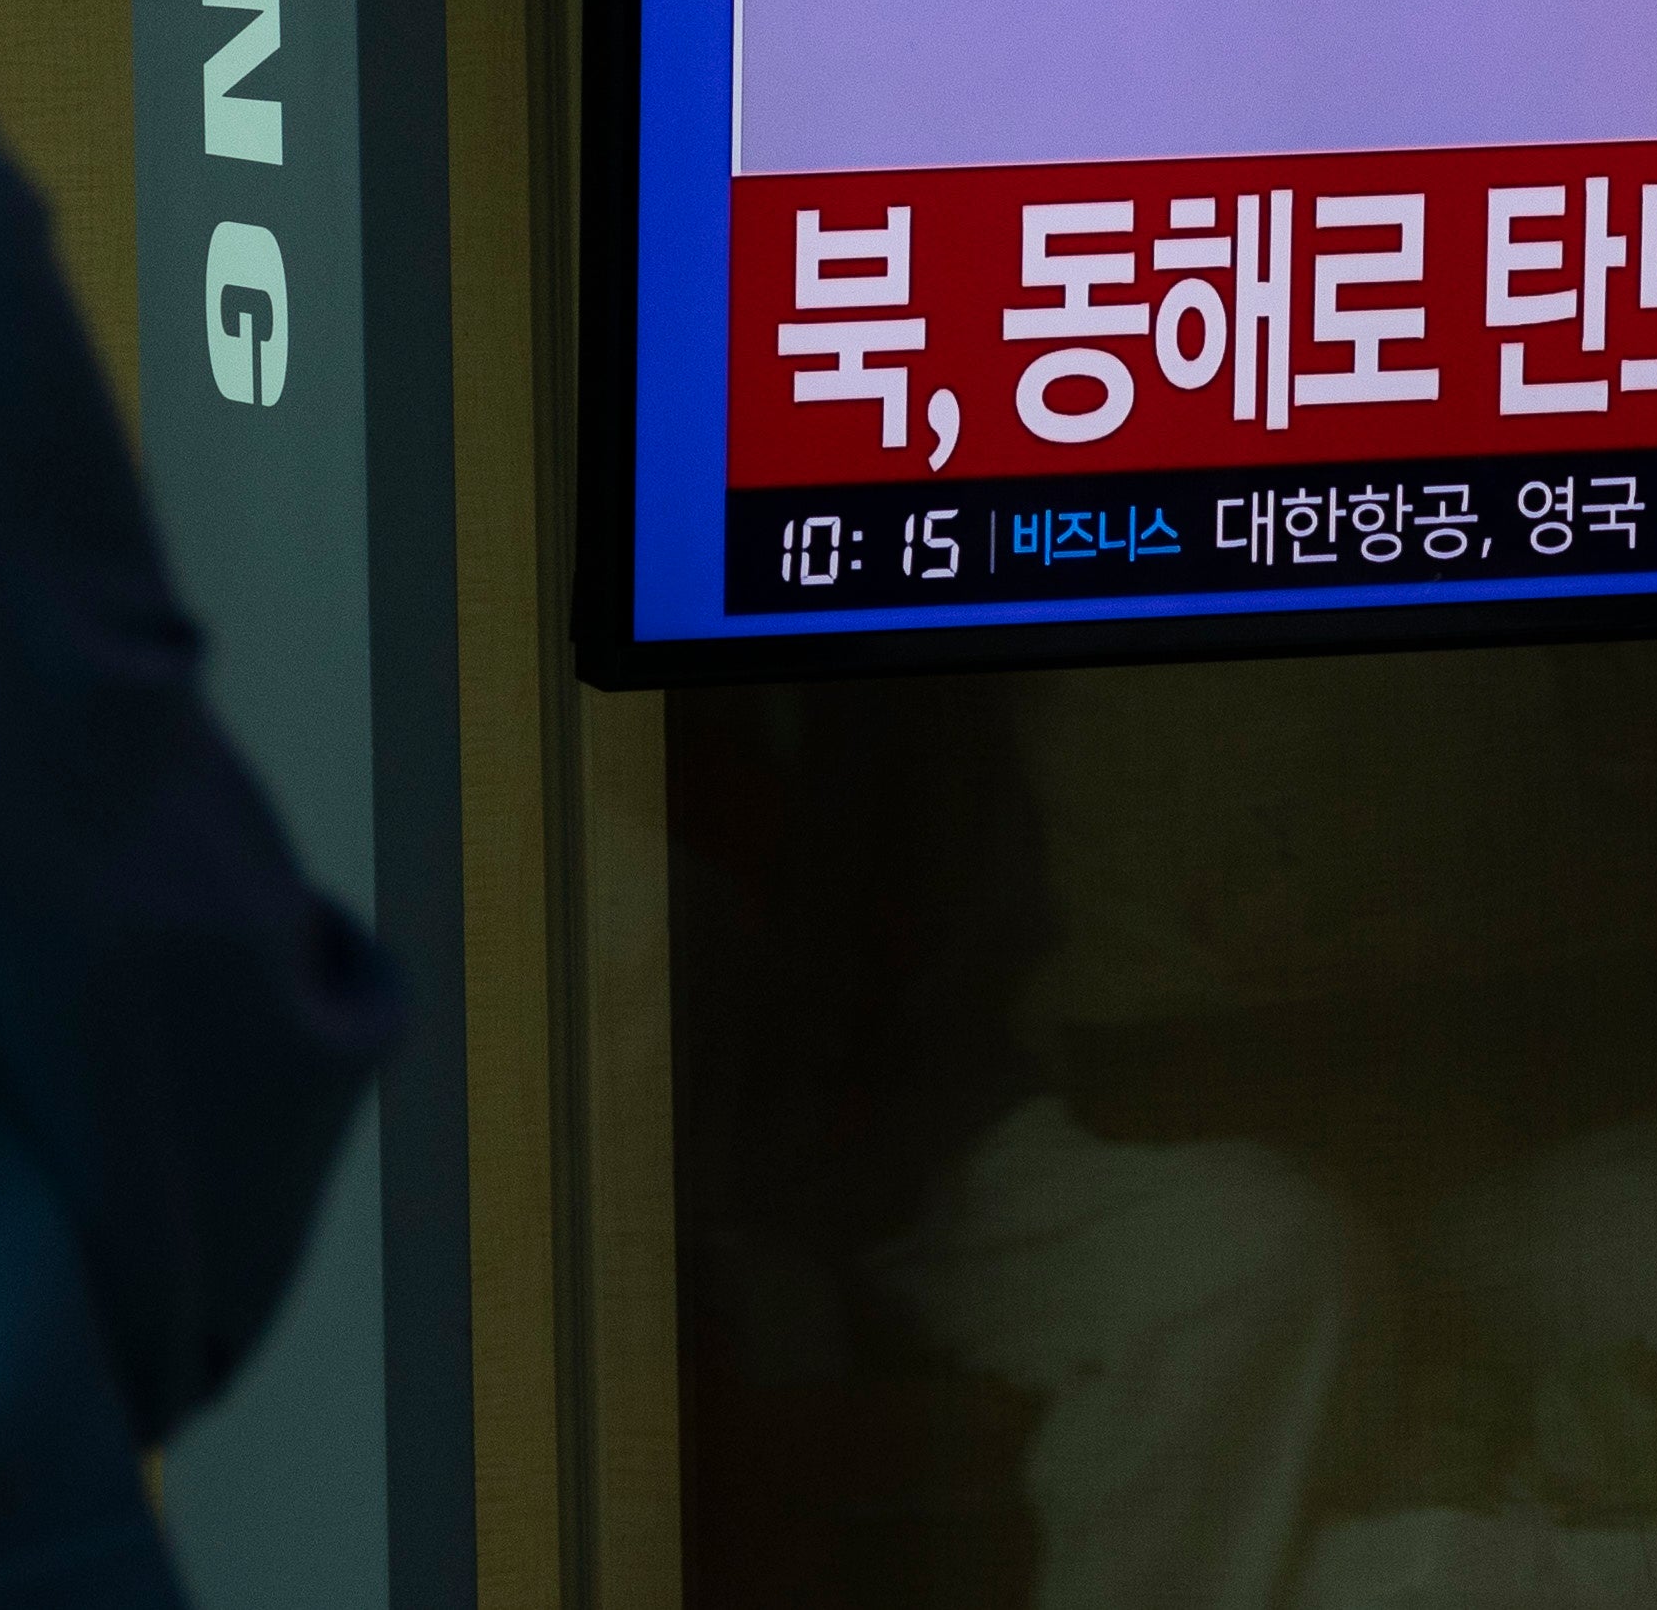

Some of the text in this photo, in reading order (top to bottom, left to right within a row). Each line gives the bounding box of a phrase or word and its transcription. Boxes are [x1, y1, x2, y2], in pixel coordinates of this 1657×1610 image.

[778, 206, 960, 471] 북,
[1003, 189, 1439, 443] 동해로
[1013, 505, 1182, 566] 비즈니스
[1216, 483, 1492, 565] 대한항공,
[1517, 475, 1646, 555] 영국
